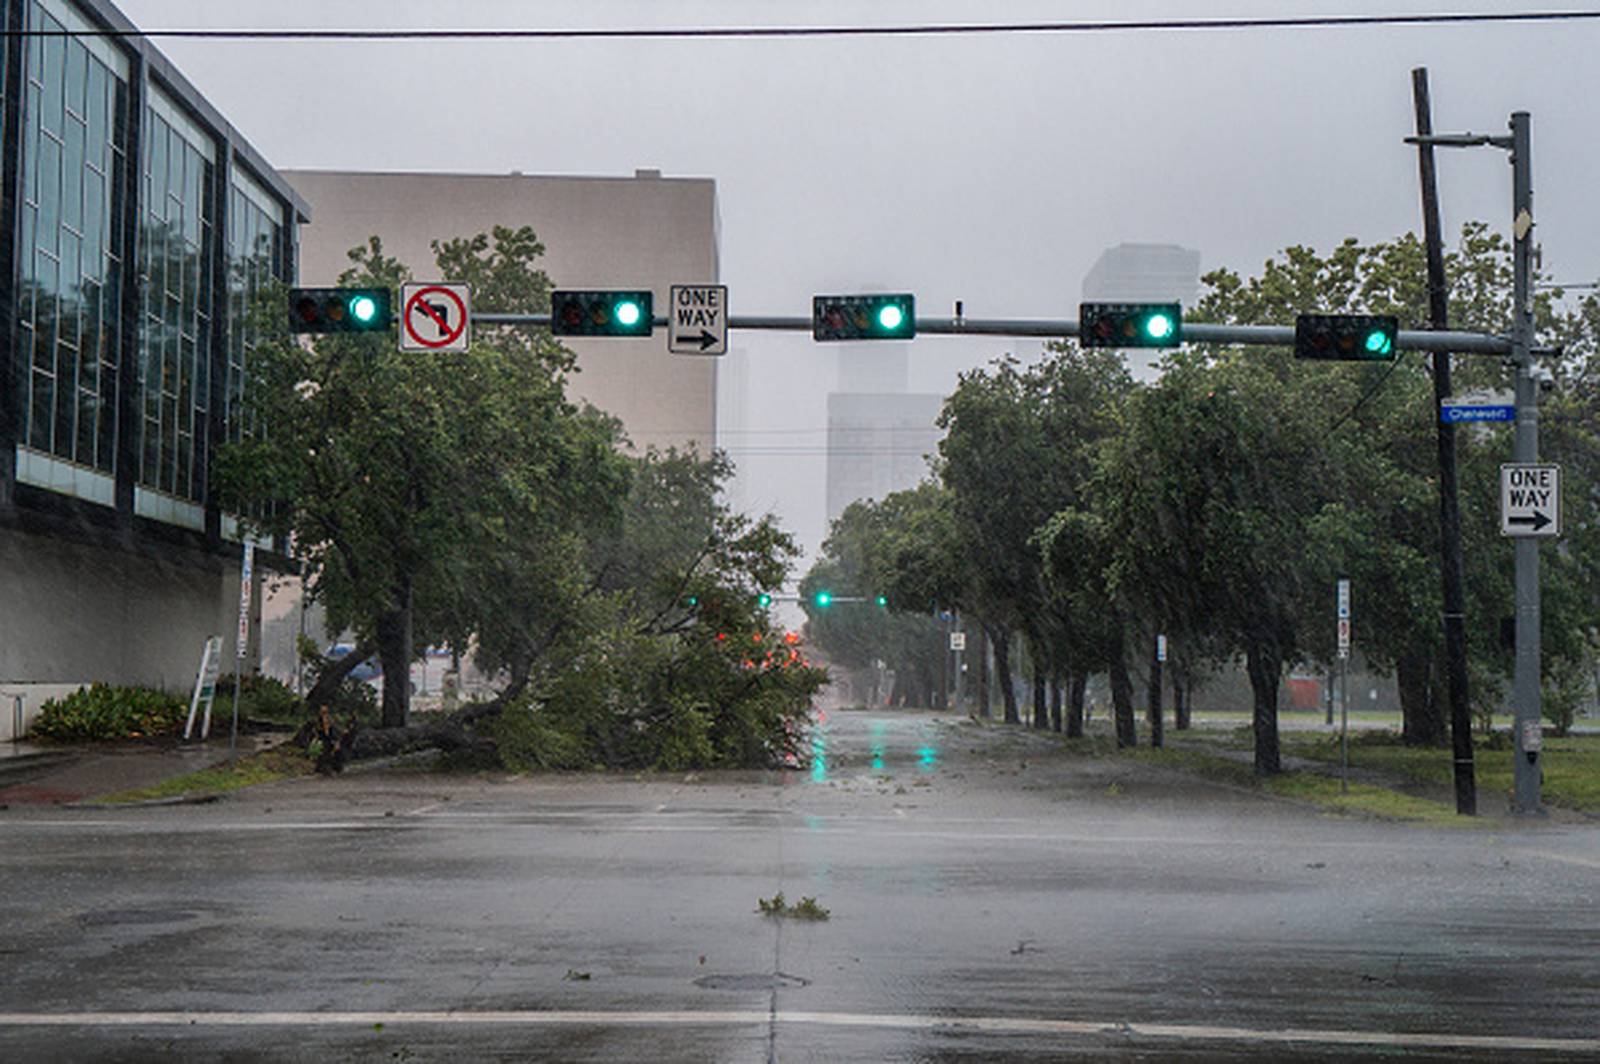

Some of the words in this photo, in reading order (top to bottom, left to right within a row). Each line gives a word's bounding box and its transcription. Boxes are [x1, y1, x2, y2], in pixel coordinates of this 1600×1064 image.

[678, 289, 718, 306] ONE
[678, 309, 718, 326] WAY
[1510, 471, 1550, 487] ONE
[1510, 490, 1550, 507] WAY
